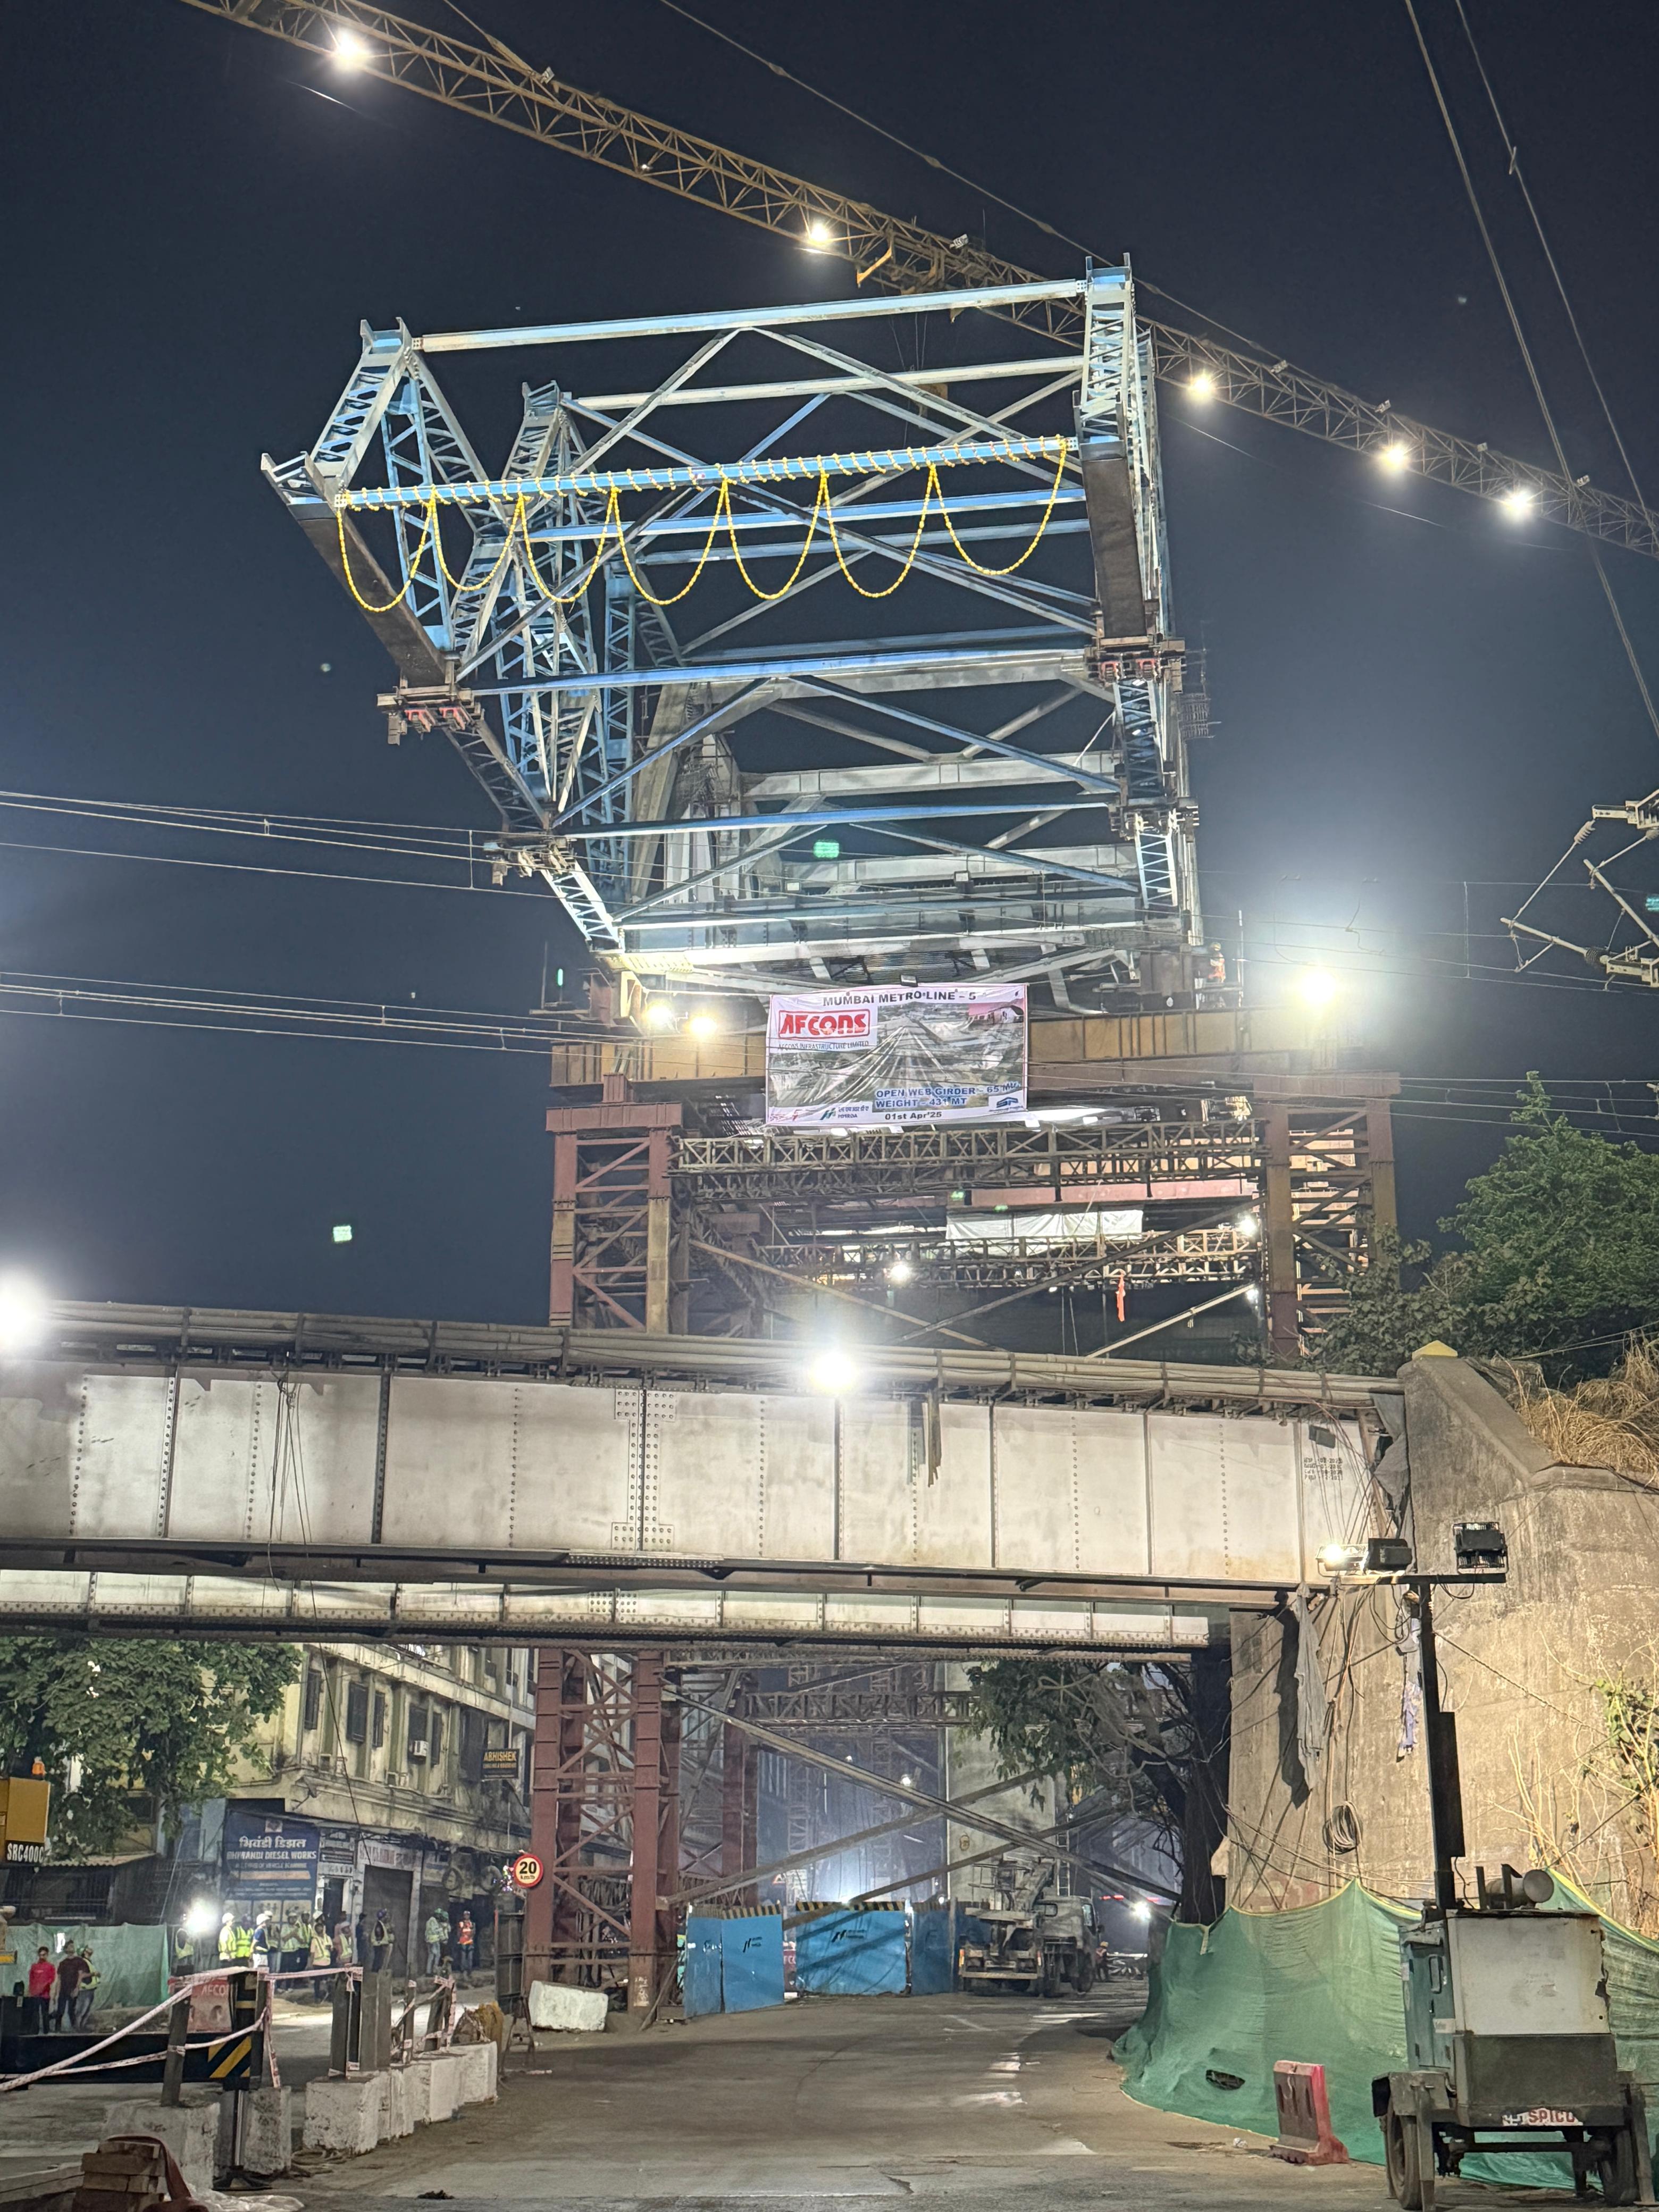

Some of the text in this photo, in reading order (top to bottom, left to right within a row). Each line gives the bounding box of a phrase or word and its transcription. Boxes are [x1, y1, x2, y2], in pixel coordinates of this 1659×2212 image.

[823, 995, 874, 1006] MUMBAI
[879, 991, 922, 1003] METRO
[927, 991, 956, 1000] LINE
[780, 1013, 867, 1035] AFCONS
[876, 1089, 904, 1097] OPEN
[935, 1087, 976, 1095] GIRDER
[876, 1099, 918, 1108] WEIGHT
[910, 1111, 942, 1120] Apr'25
[483, 1751, 517, 1762] ABHISHEK
[265, 1851, 290, 1859] DIESEL
[291, 1850, 317, 1859] WORKS
[520, 1861, 537, 1874] 20
